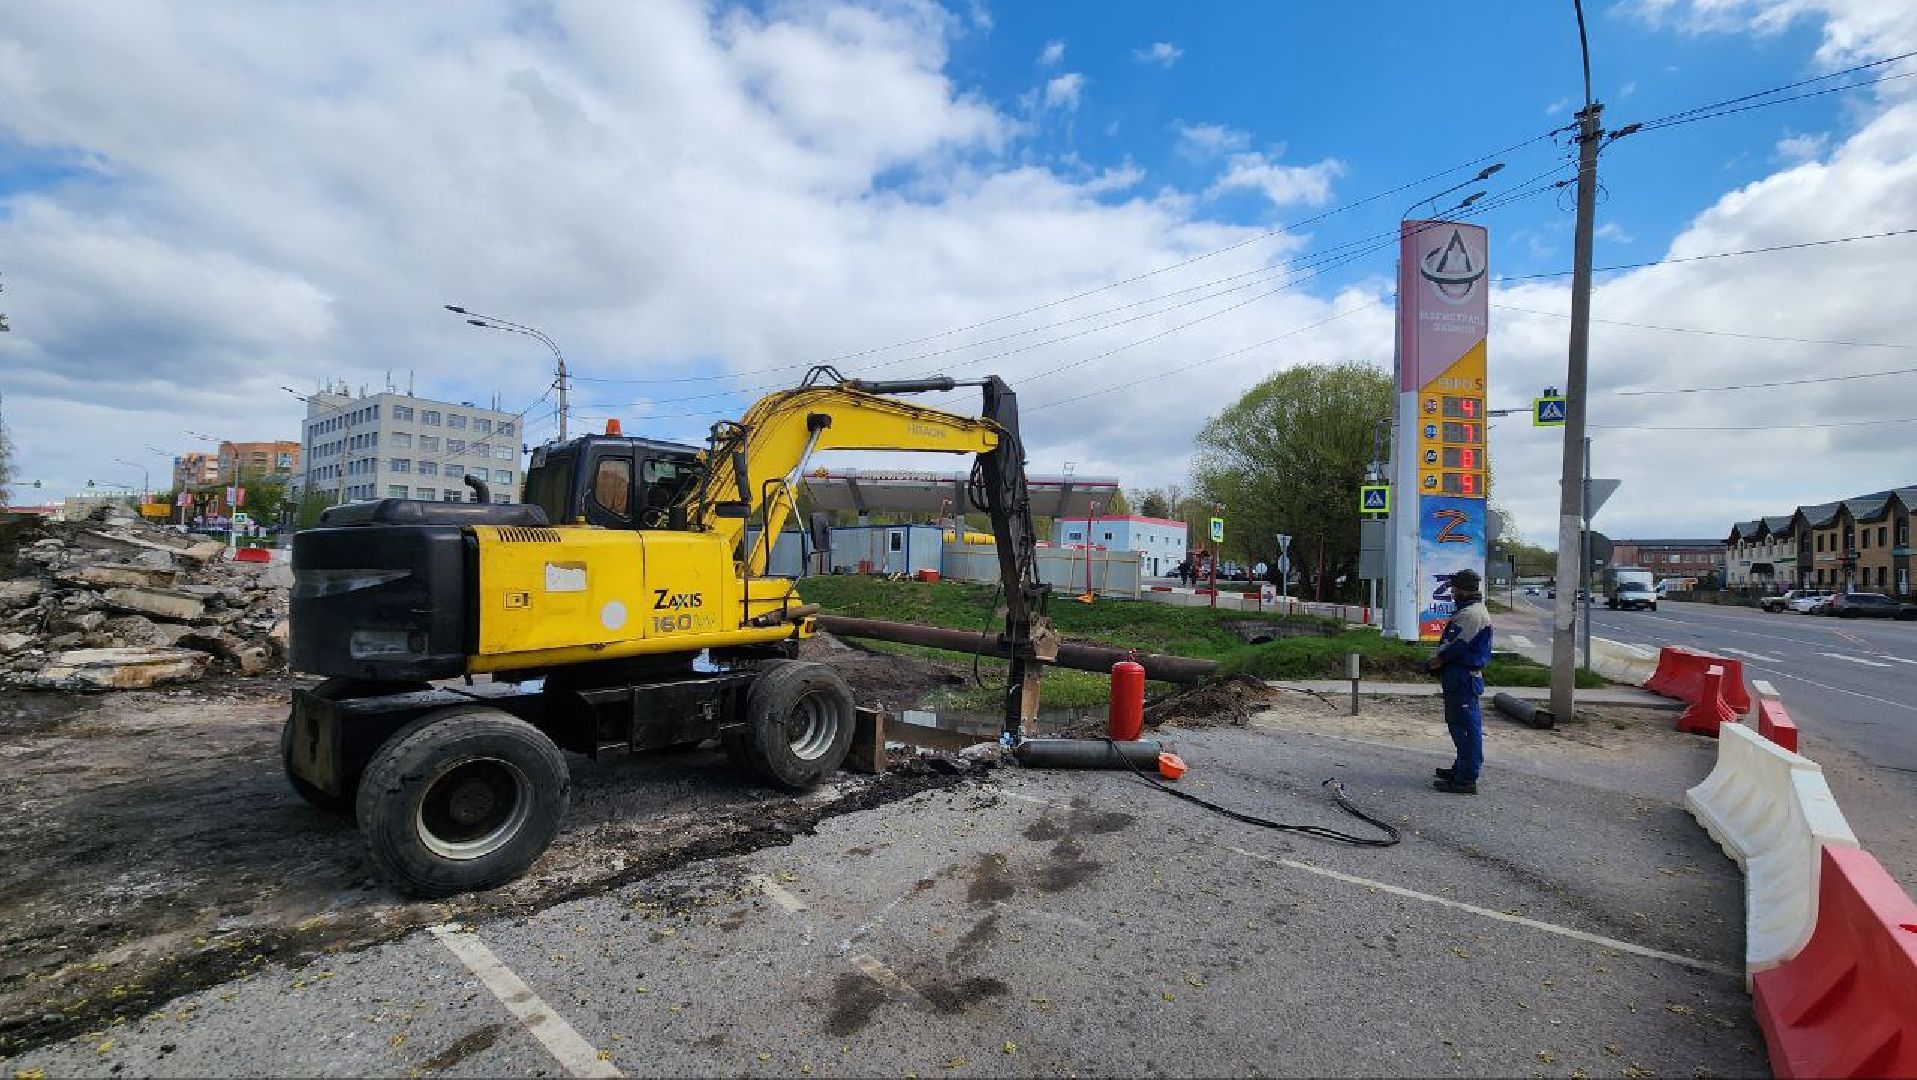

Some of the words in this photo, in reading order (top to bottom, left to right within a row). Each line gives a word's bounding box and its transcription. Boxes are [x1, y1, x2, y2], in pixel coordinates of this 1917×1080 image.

[1475, 378, 1483, 391] 5
[1462, 400, 1473, 418] 4
[1462, 424, 1473, 442] 7
[1462, 449, 1473, 469] 8
[1462, 474, 1473, 493] 9
[1432, 508, 1472, 543] Z
